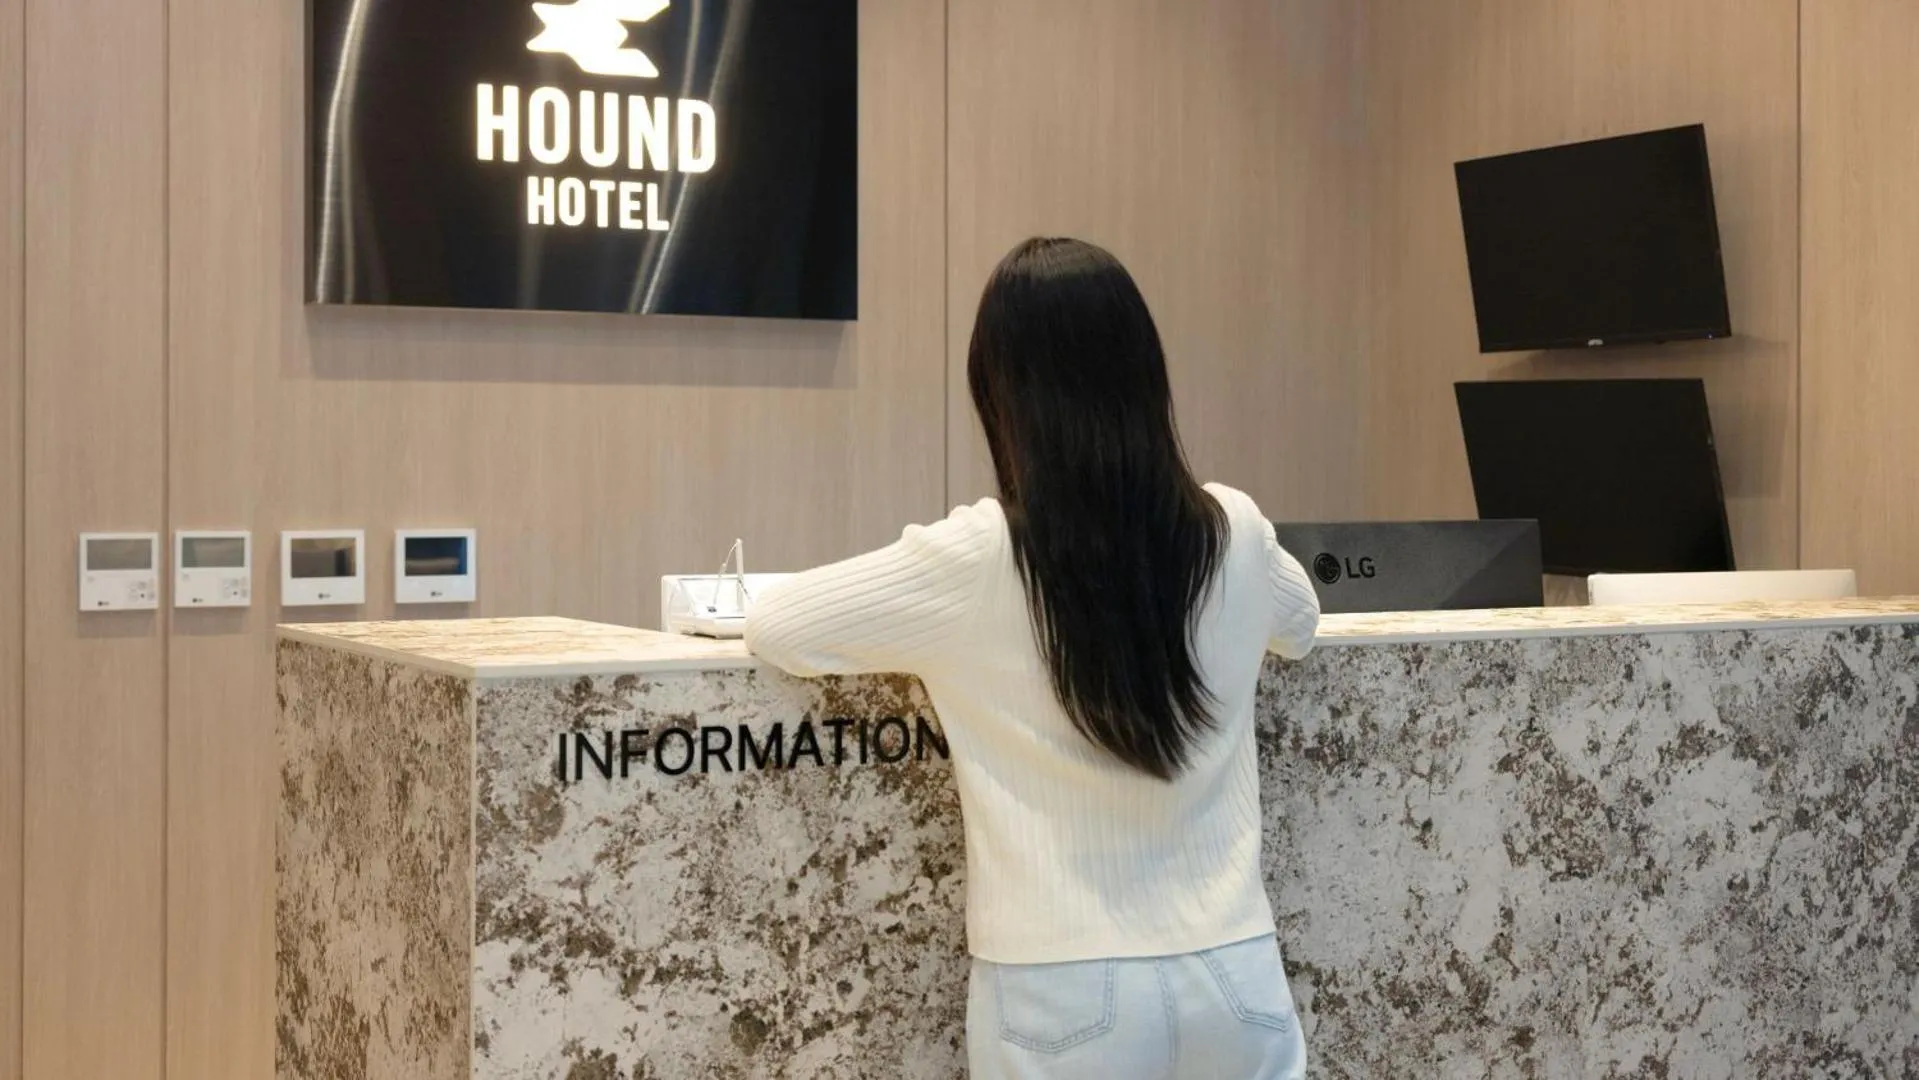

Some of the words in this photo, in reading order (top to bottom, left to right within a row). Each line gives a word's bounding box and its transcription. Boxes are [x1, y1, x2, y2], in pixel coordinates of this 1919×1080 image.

[476, 83, 716, 173] HOUND
[527, 176, 670, 231] HOTEL
[1344, 556, 1376, 579] LG
[558, 716, 950, 782] INFORMATION
